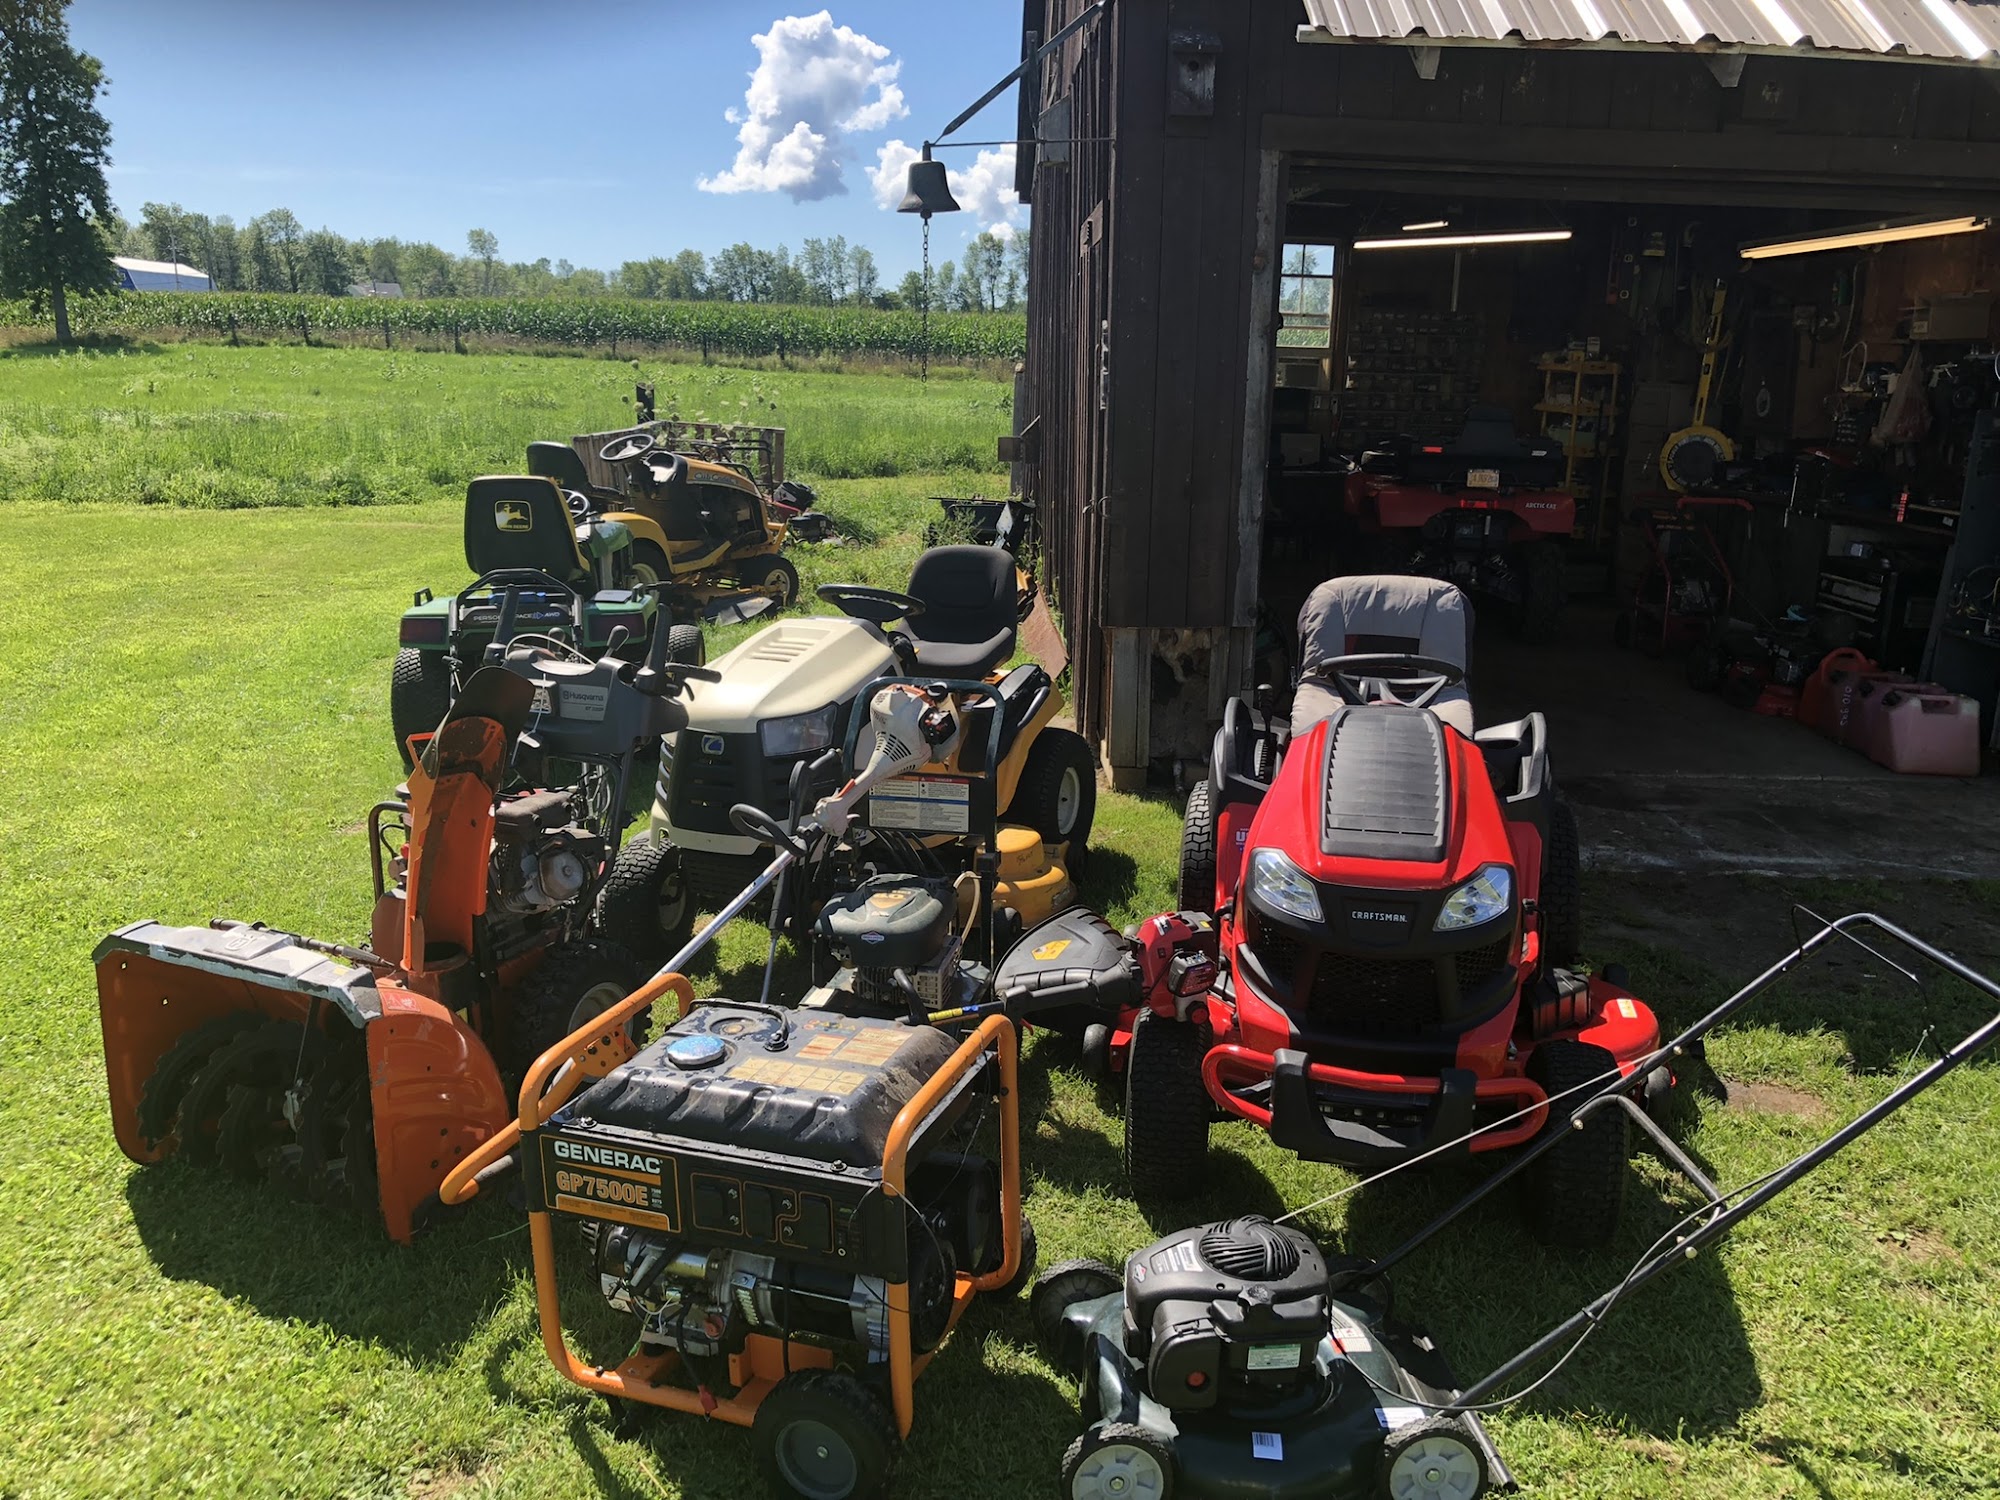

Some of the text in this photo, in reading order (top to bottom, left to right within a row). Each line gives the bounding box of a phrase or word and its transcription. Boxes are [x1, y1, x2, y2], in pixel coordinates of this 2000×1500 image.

[694, 472, 711, 481] Cub
[544, 611, 561, 619] AWD
[569, 691, 604, 702] Husqvarna
[1352, 911, 1407, 922] CRAFTSMAN
[554, 1141, 660, 1174] GENERAC
[556, 1171, 648, 1206] GP7500E
